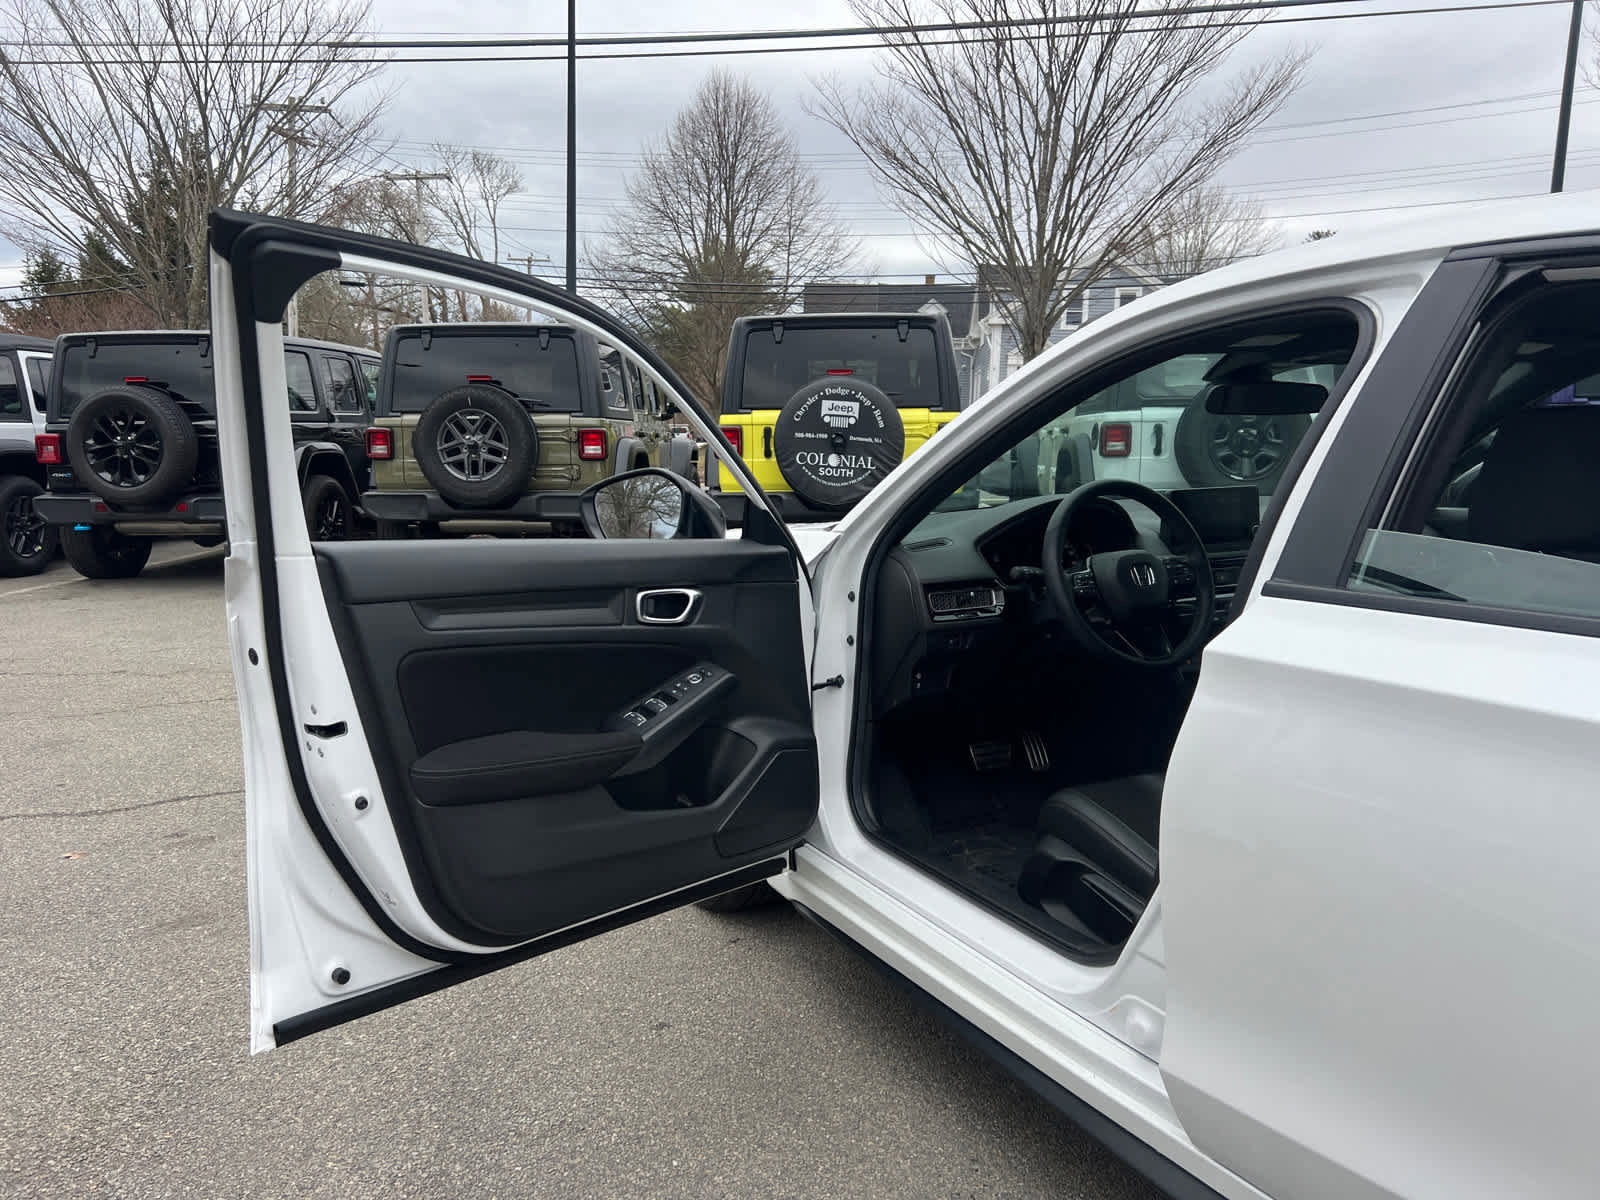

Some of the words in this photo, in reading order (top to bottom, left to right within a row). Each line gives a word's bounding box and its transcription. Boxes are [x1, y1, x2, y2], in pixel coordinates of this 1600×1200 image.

[793, 394, 819, 421] Chrysler
[825, 387, 850, 396] Dodge
[855, 392, 872, 406] Jeep
[873, 409, 885, 428] Ram
[828, 403, 854, 413] Jeep
[796, 451, 876, 470] COLONIAL
[818, 467, 854, 477] SOUTH
